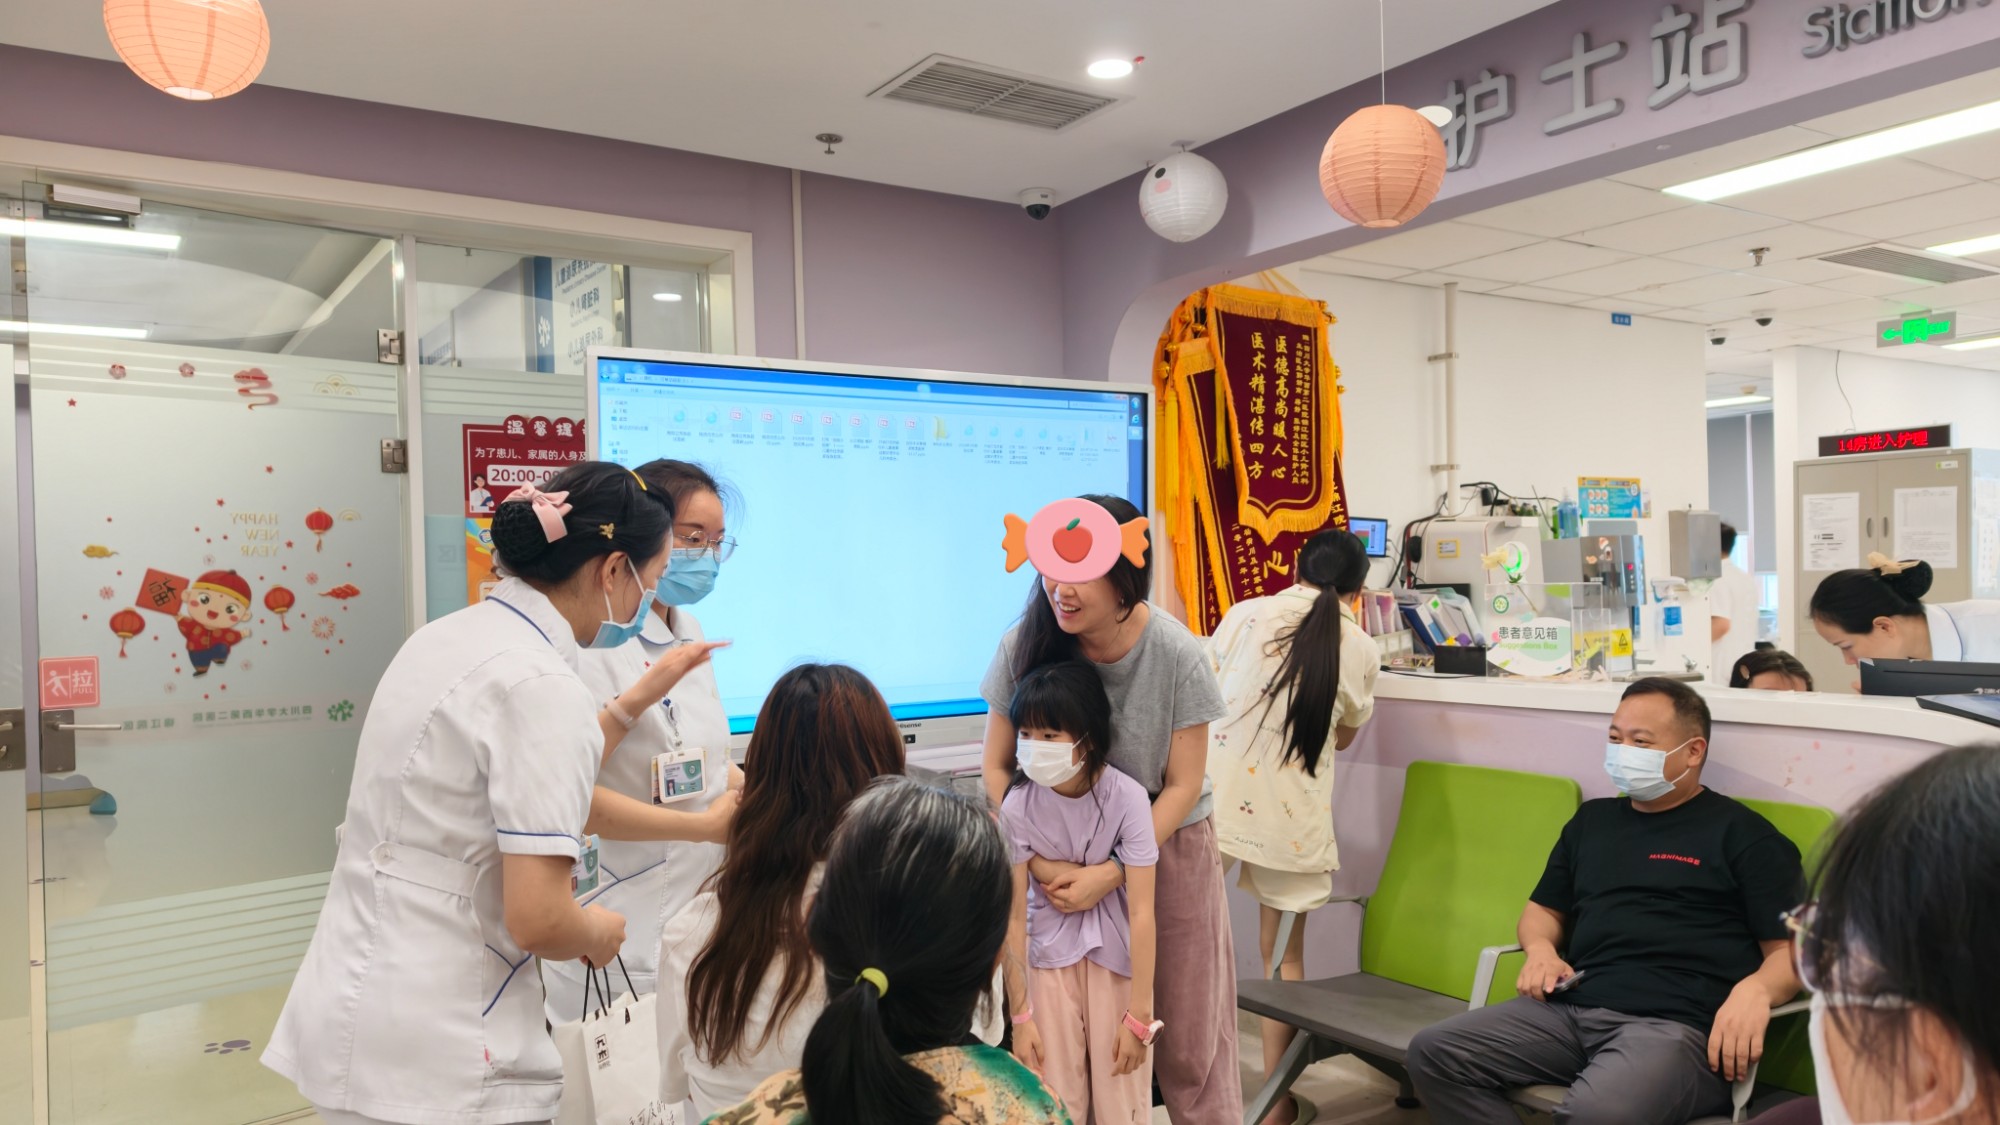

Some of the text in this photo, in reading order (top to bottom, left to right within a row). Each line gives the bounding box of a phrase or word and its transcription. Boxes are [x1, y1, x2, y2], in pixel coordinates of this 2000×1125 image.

[1441, 0, 1751, 170] 护士站
[1248, 332, 1267, 480] 医术精湛传四方
[1271, 335, 1290, 480] 医德高尚暖人心
[507, 420, 585, 437] 温馨提
[1498, 626, 1558, 641] 患者意见箱
[1498, 641, 1558, 651] Suggestions Box
[72, 669, 94, 687] 拉
